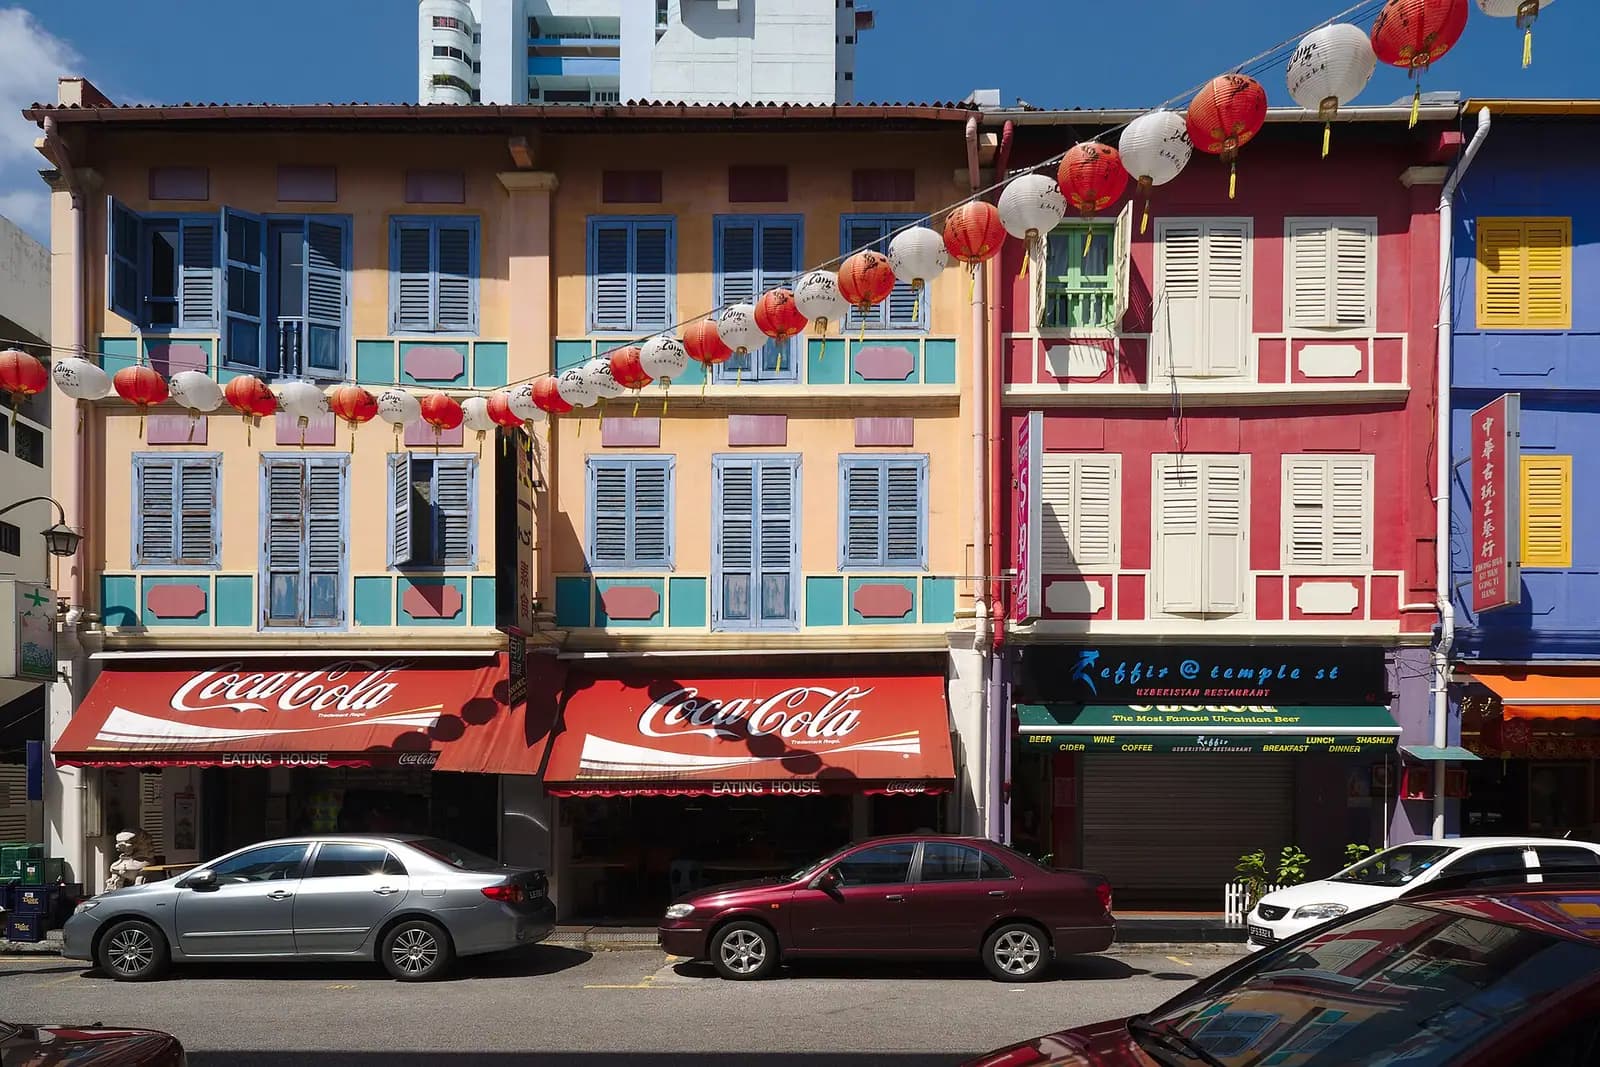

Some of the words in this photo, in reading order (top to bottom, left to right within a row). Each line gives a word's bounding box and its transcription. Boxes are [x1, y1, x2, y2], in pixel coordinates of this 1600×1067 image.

[1179, 659, 1200, 680] @
[1210, 664, 1301, 686] temple
[1315, 665, 1340, 680] st
[170, 659, 416, 713] Coca-Cola
[1136, 688, 1200, 697] UZBEKISTAN
[1204, 688, 1271, 697] RESTAURANT
[637, 686, 875, 738] Coca-Cola
[1212, 715, 1272, 723] Ukrainian
[1029, 735, 1052, 743] BEER
[1093, 735, 1116, 744] WINE
[1306, 736, 1335, 744] LUNCH
[1356, 736, 1395, 744] SHASHLIK
[1262, 744, 1310, 752] BREAKFAST
[1328, 745, 1361, 753] DINNER
[222, 753, 272, 765] EATING
[280, 753, 328, 765] HOUSE
[712, 781, 763, 793] EATING
[772, 781, 820, 793] HOUSE
